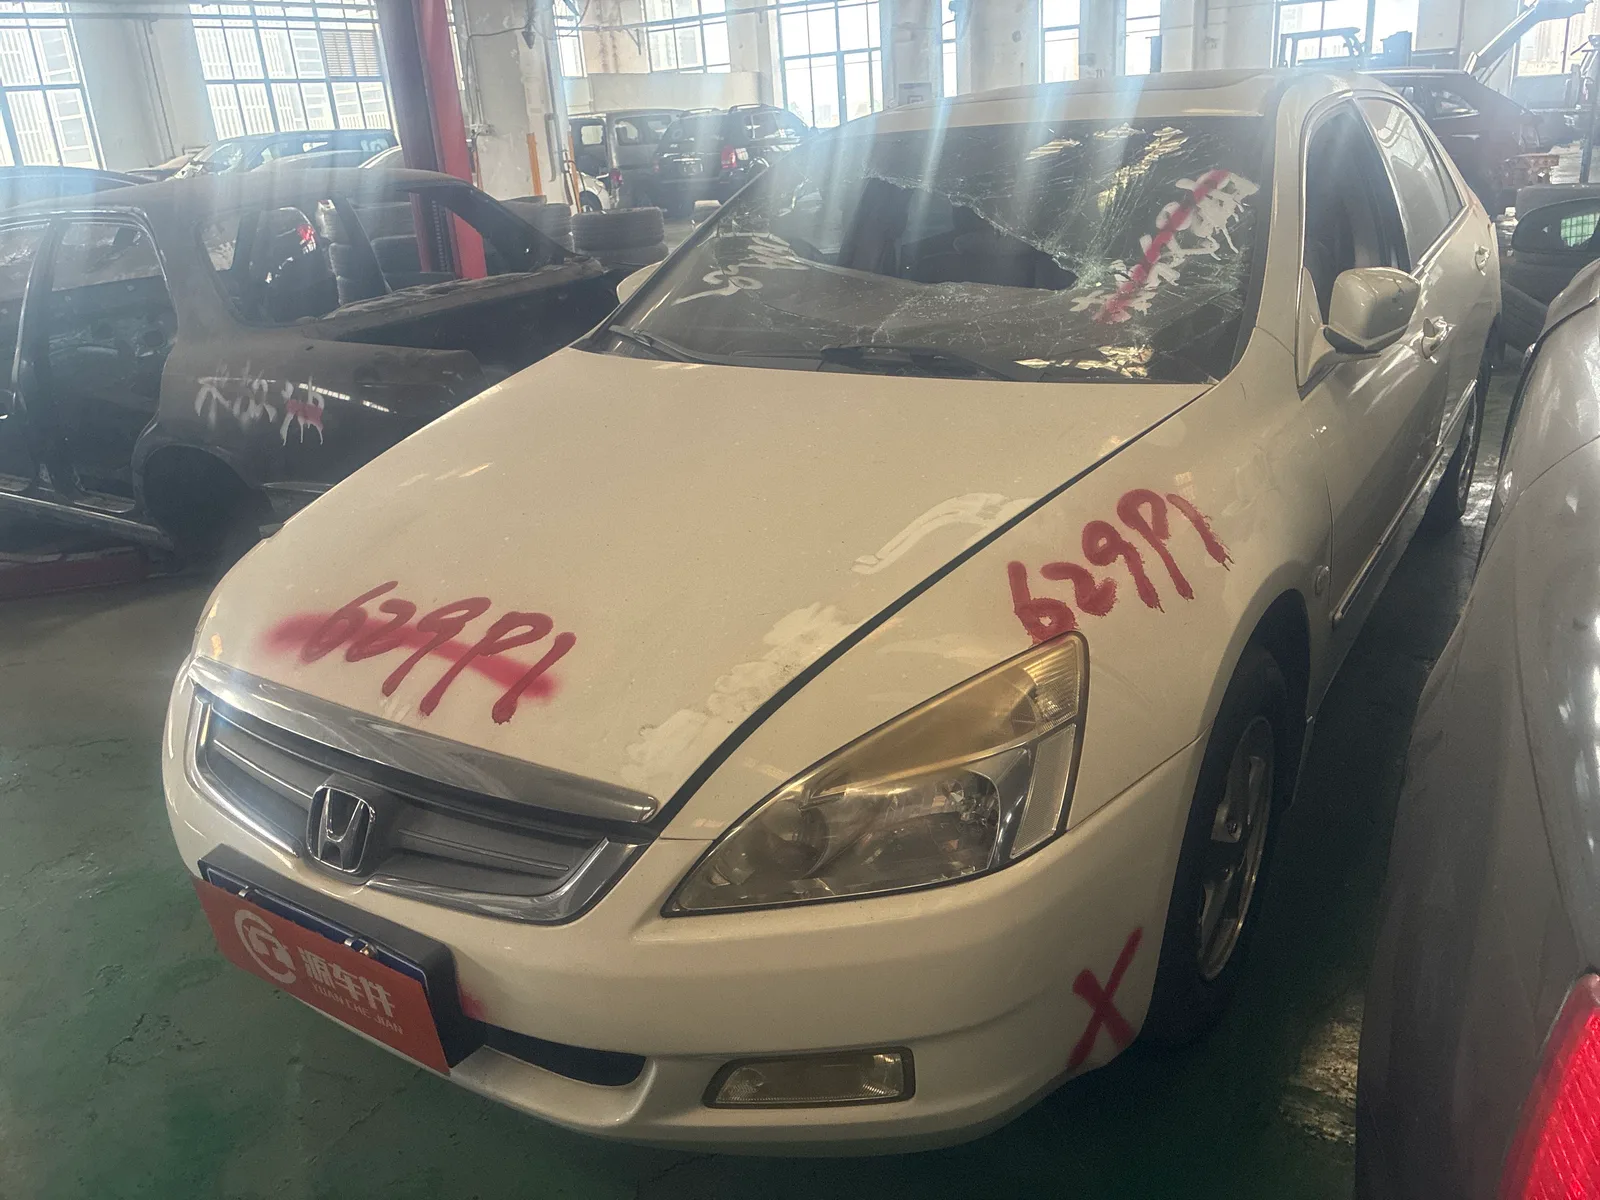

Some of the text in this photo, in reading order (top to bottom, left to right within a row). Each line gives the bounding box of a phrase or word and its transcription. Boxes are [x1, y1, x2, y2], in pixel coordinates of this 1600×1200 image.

[297, 946, 396, 1018] 源车件
[375, 1016, 404, 1035] JIAN
